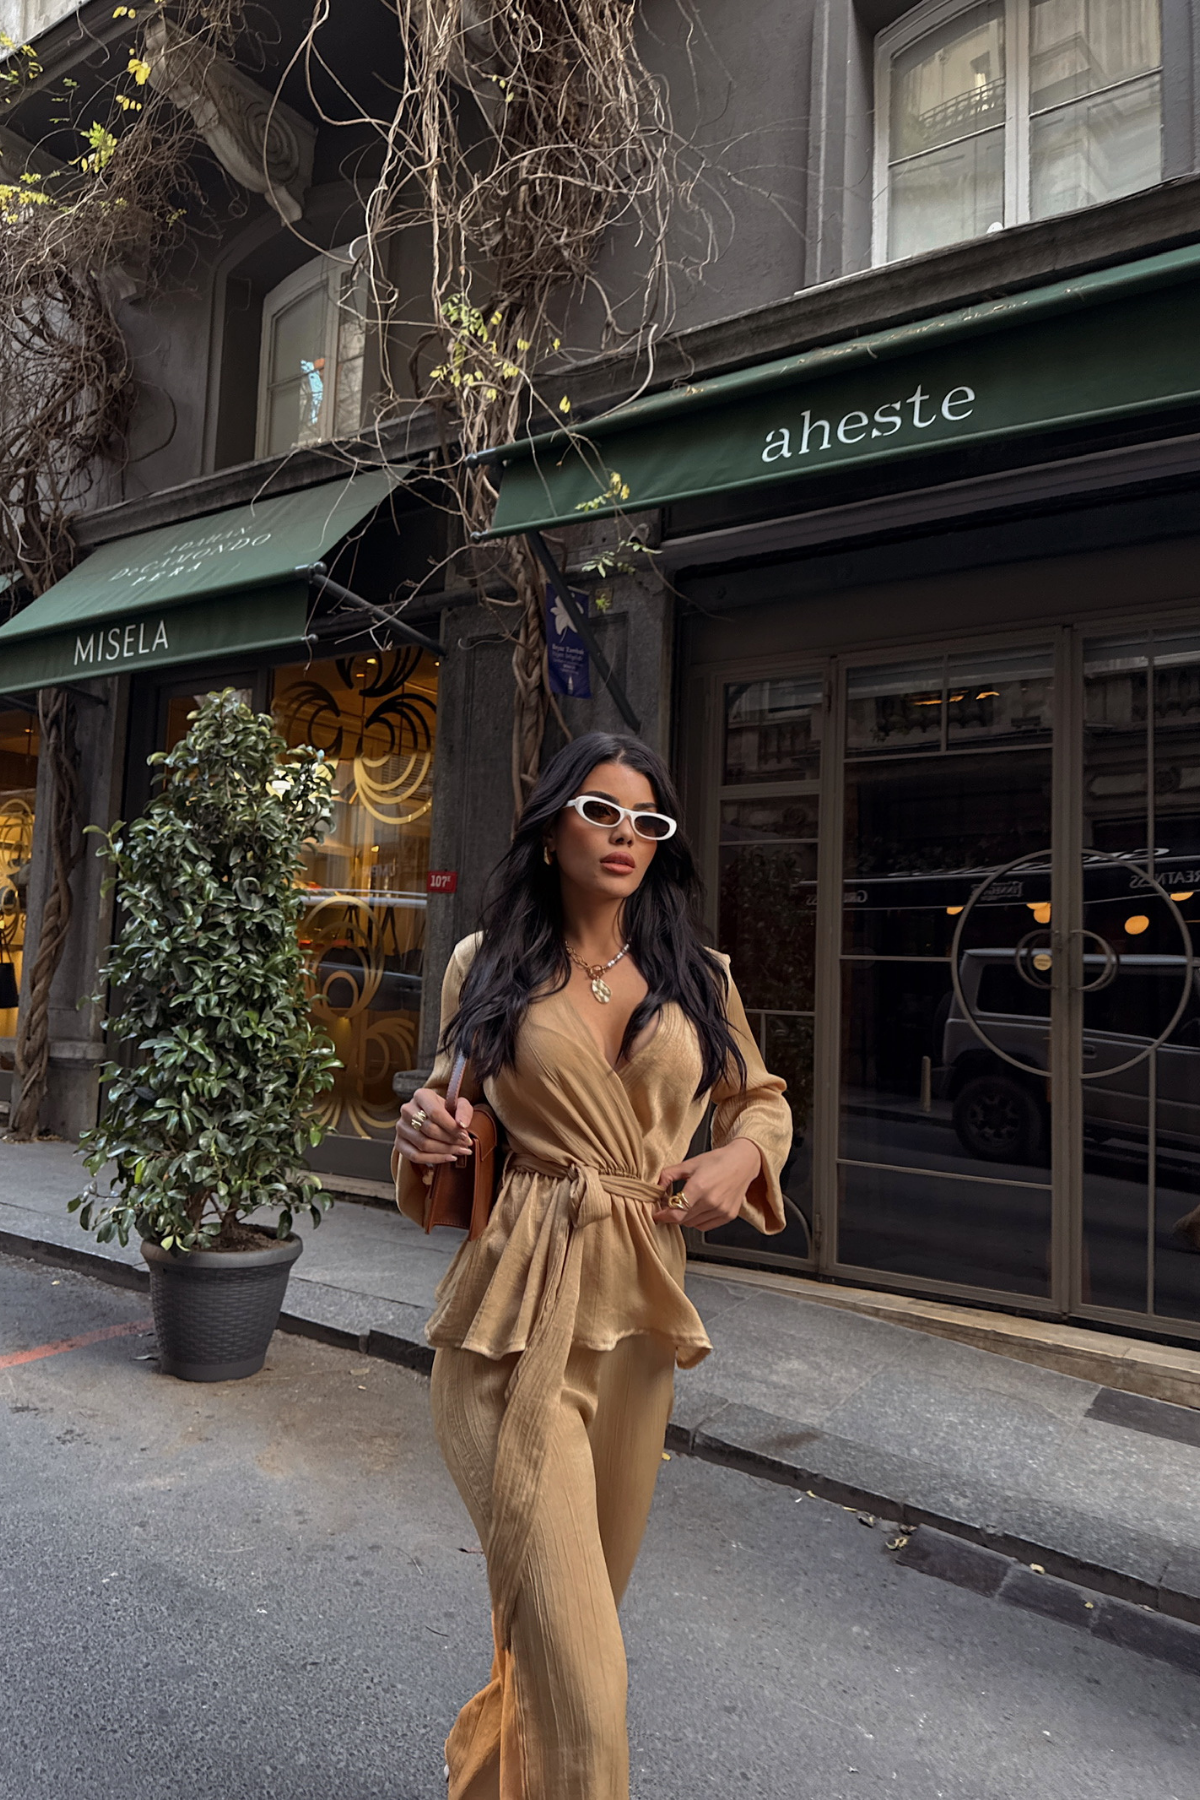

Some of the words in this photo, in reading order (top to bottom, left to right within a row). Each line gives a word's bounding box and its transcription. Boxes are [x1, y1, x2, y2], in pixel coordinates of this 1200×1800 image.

[761, 384, 976, 463] aheste
[130, 561, 202, 587] PERA
[73, 619, 169, 666] MISELA
